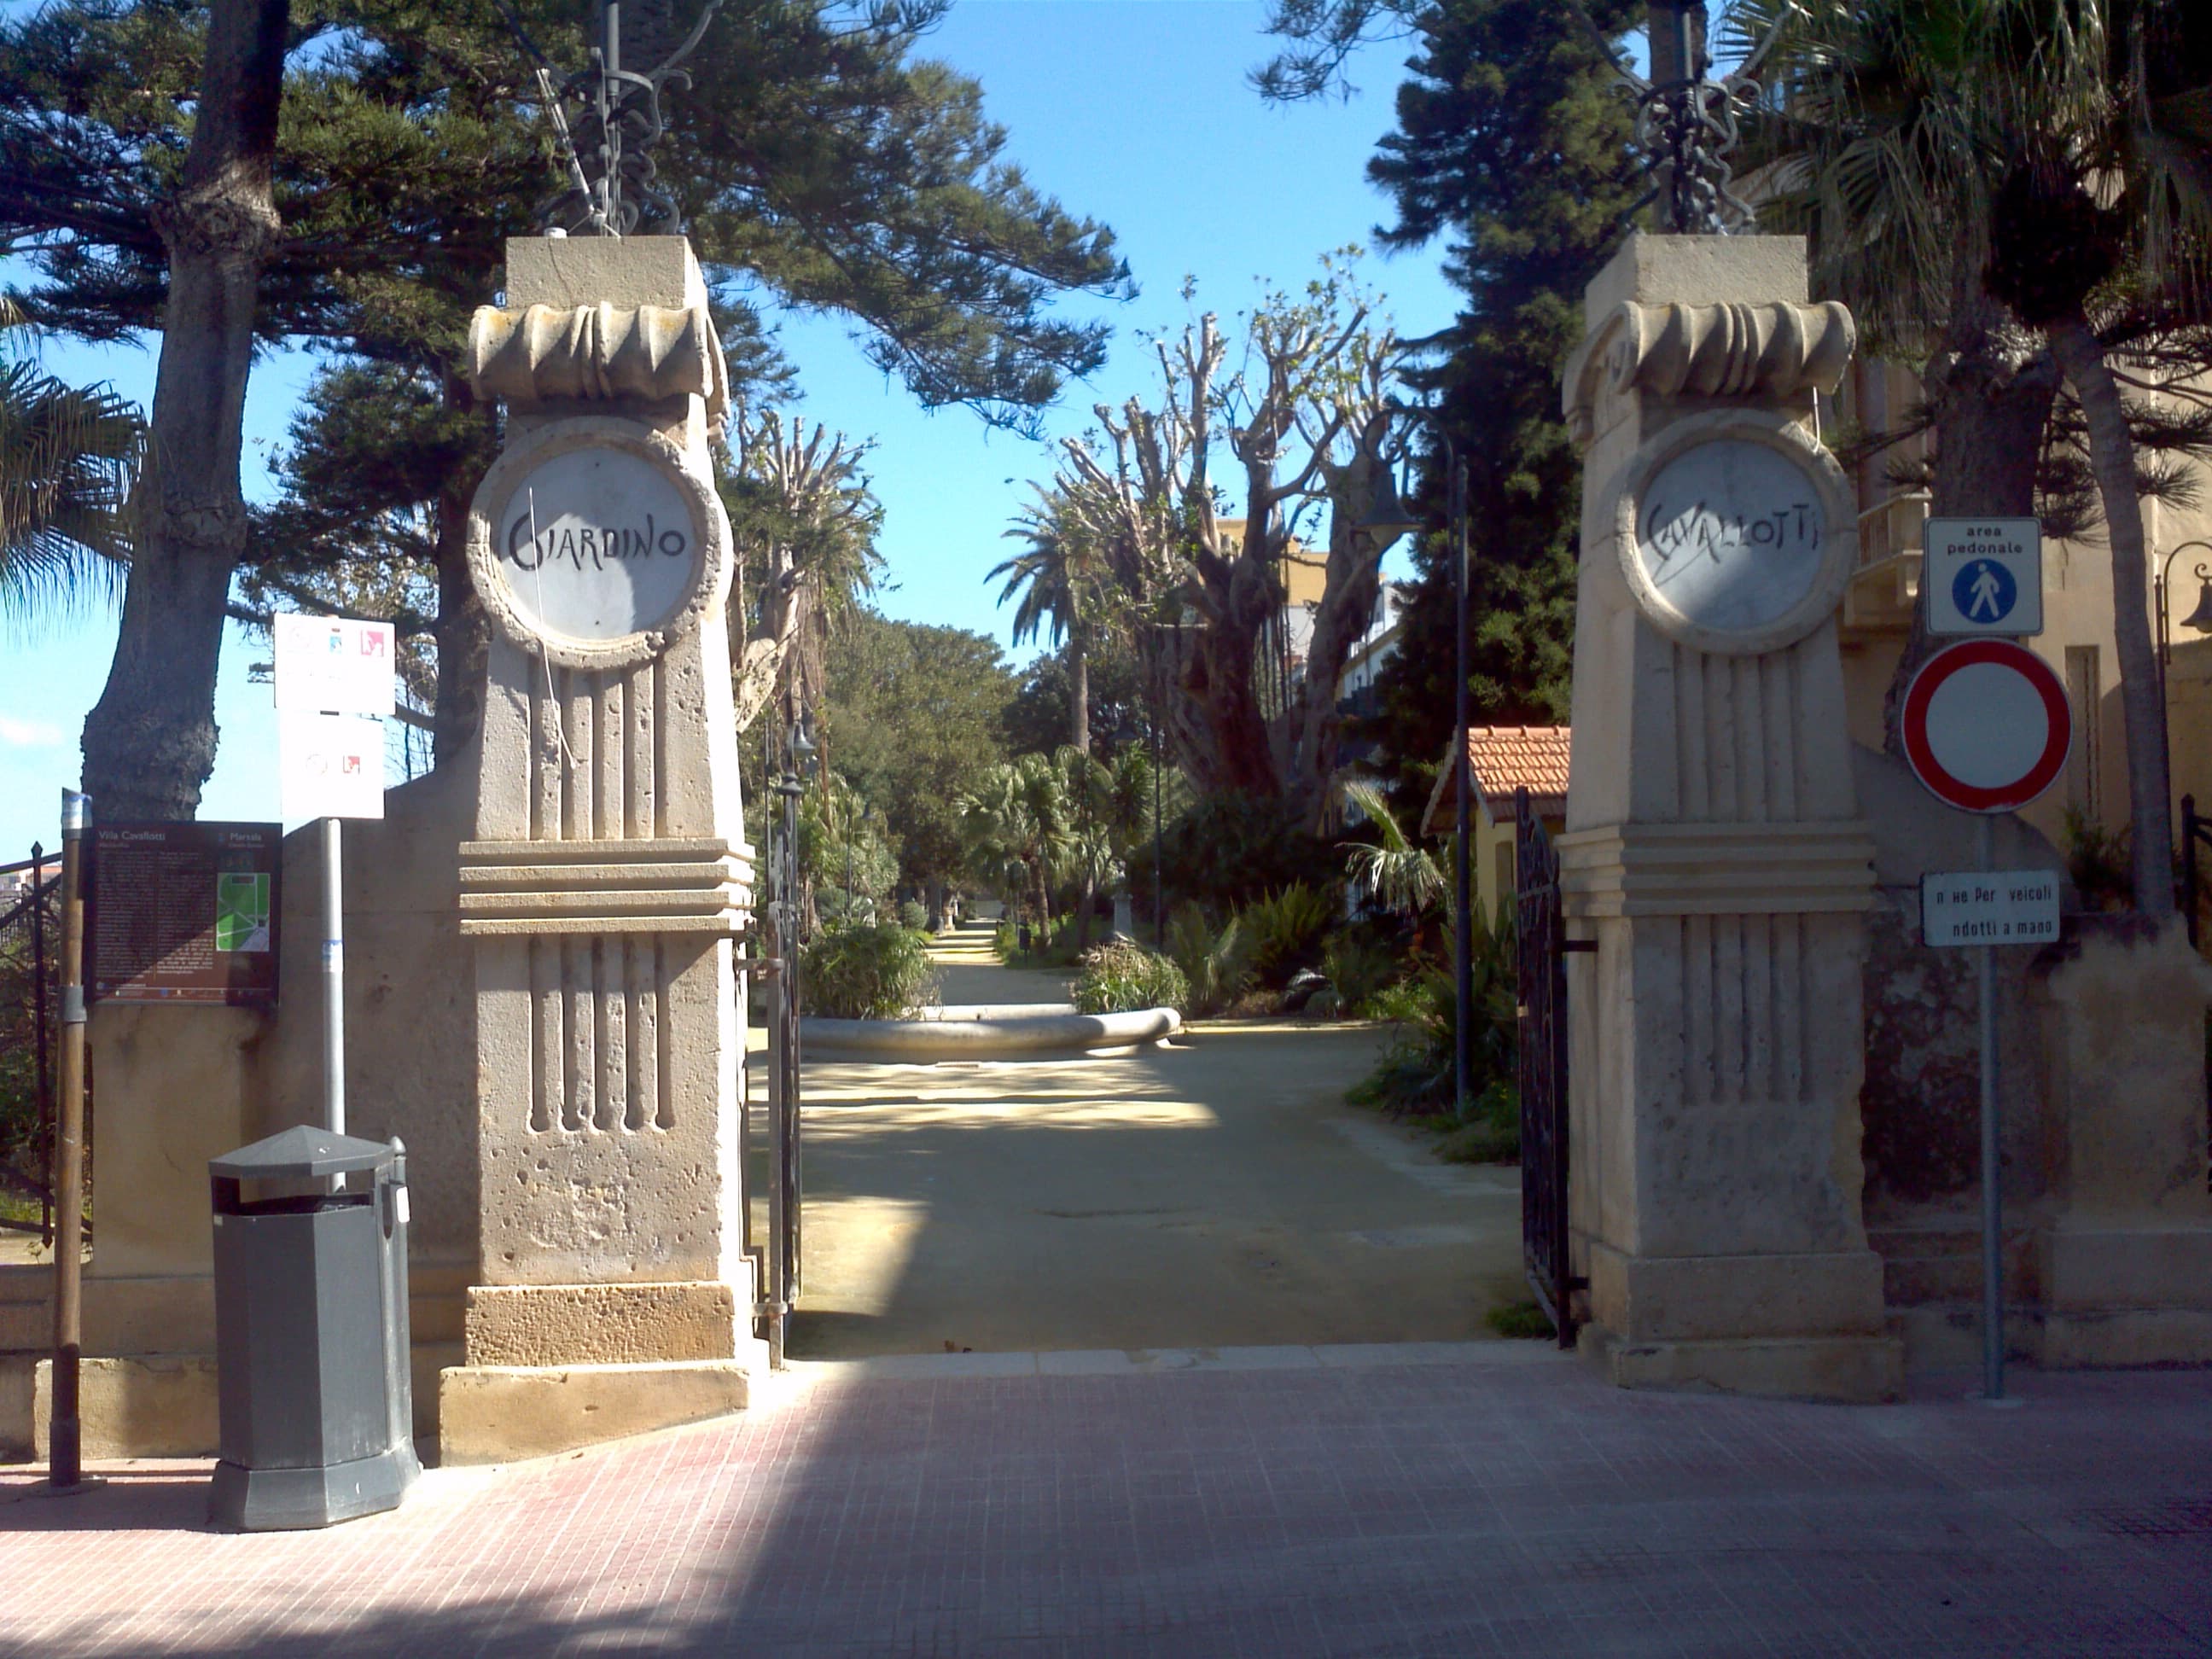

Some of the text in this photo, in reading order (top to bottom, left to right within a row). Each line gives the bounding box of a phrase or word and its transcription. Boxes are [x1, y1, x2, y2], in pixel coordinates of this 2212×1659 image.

[1646, 501, 1819, 564] CAVALLOTTI
[1966, 526, 2002, 537] area
[508, 511, 685, 571] GIARDINO
[1947, 541, 2023, 556] pedonale
[99, 830, 118, 840] Villa
[1976, 887, 1995, 903] Per
[2009, 883, 2052, 902] veicoli
[2003, 923, 2010, 935] a
[2017, 920, 2052, 935] mano
